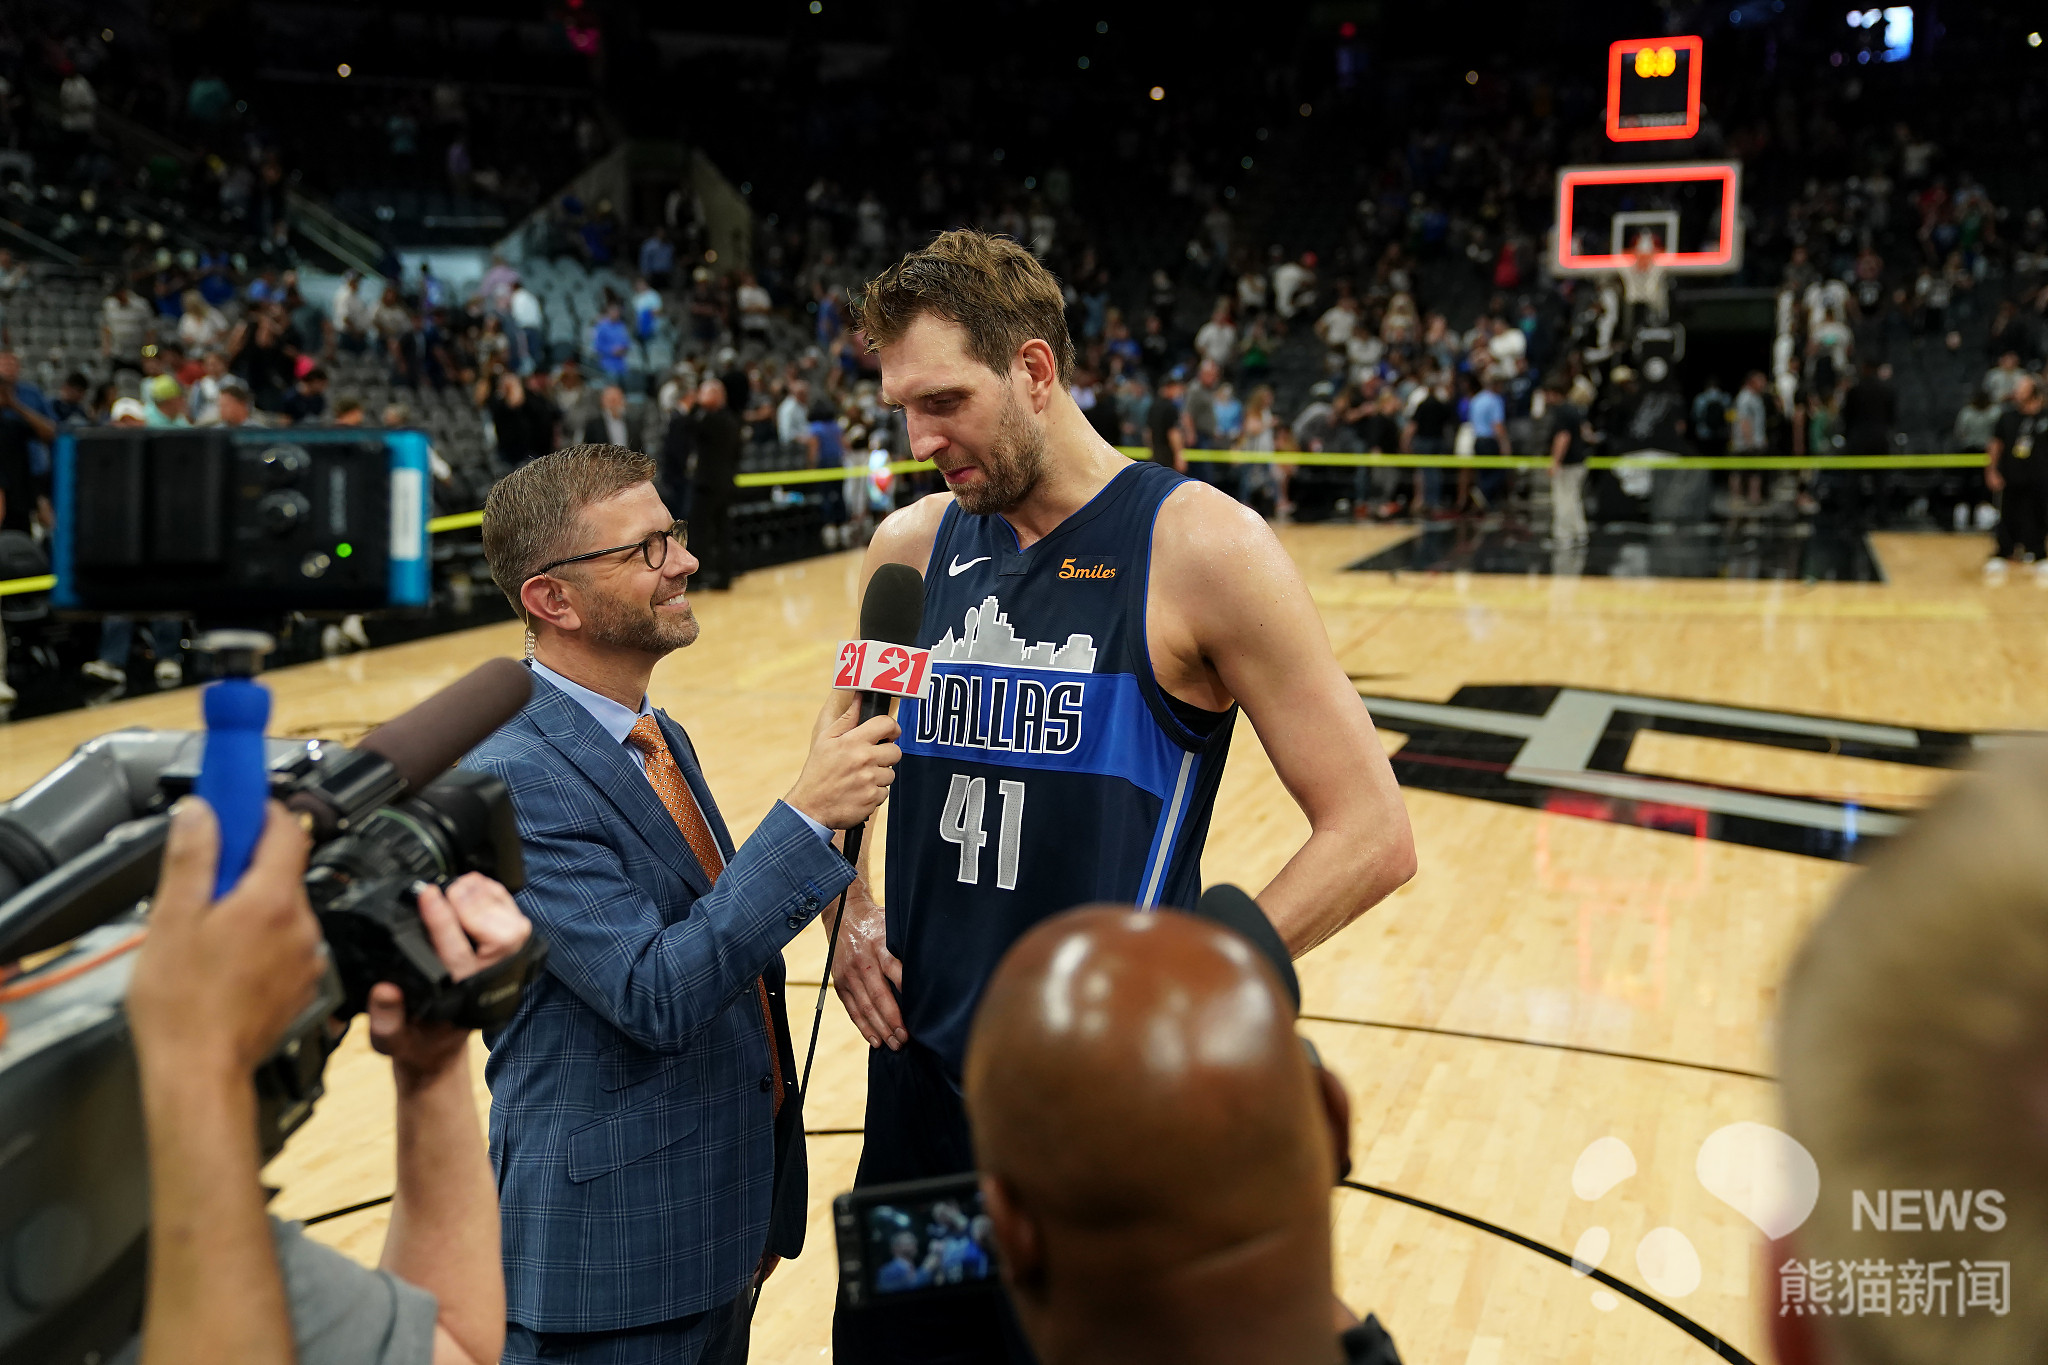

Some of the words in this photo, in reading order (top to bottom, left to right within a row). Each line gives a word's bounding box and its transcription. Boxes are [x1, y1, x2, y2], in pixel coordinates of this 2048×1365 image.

[1059, 558, 1116, 579] 5miles
[835, 642, 867, 686] 21
[871, 647, 929, 694] 21
[916, 674, 1085, 754] DALLAS
[940, 774, 1025, 890] 41
